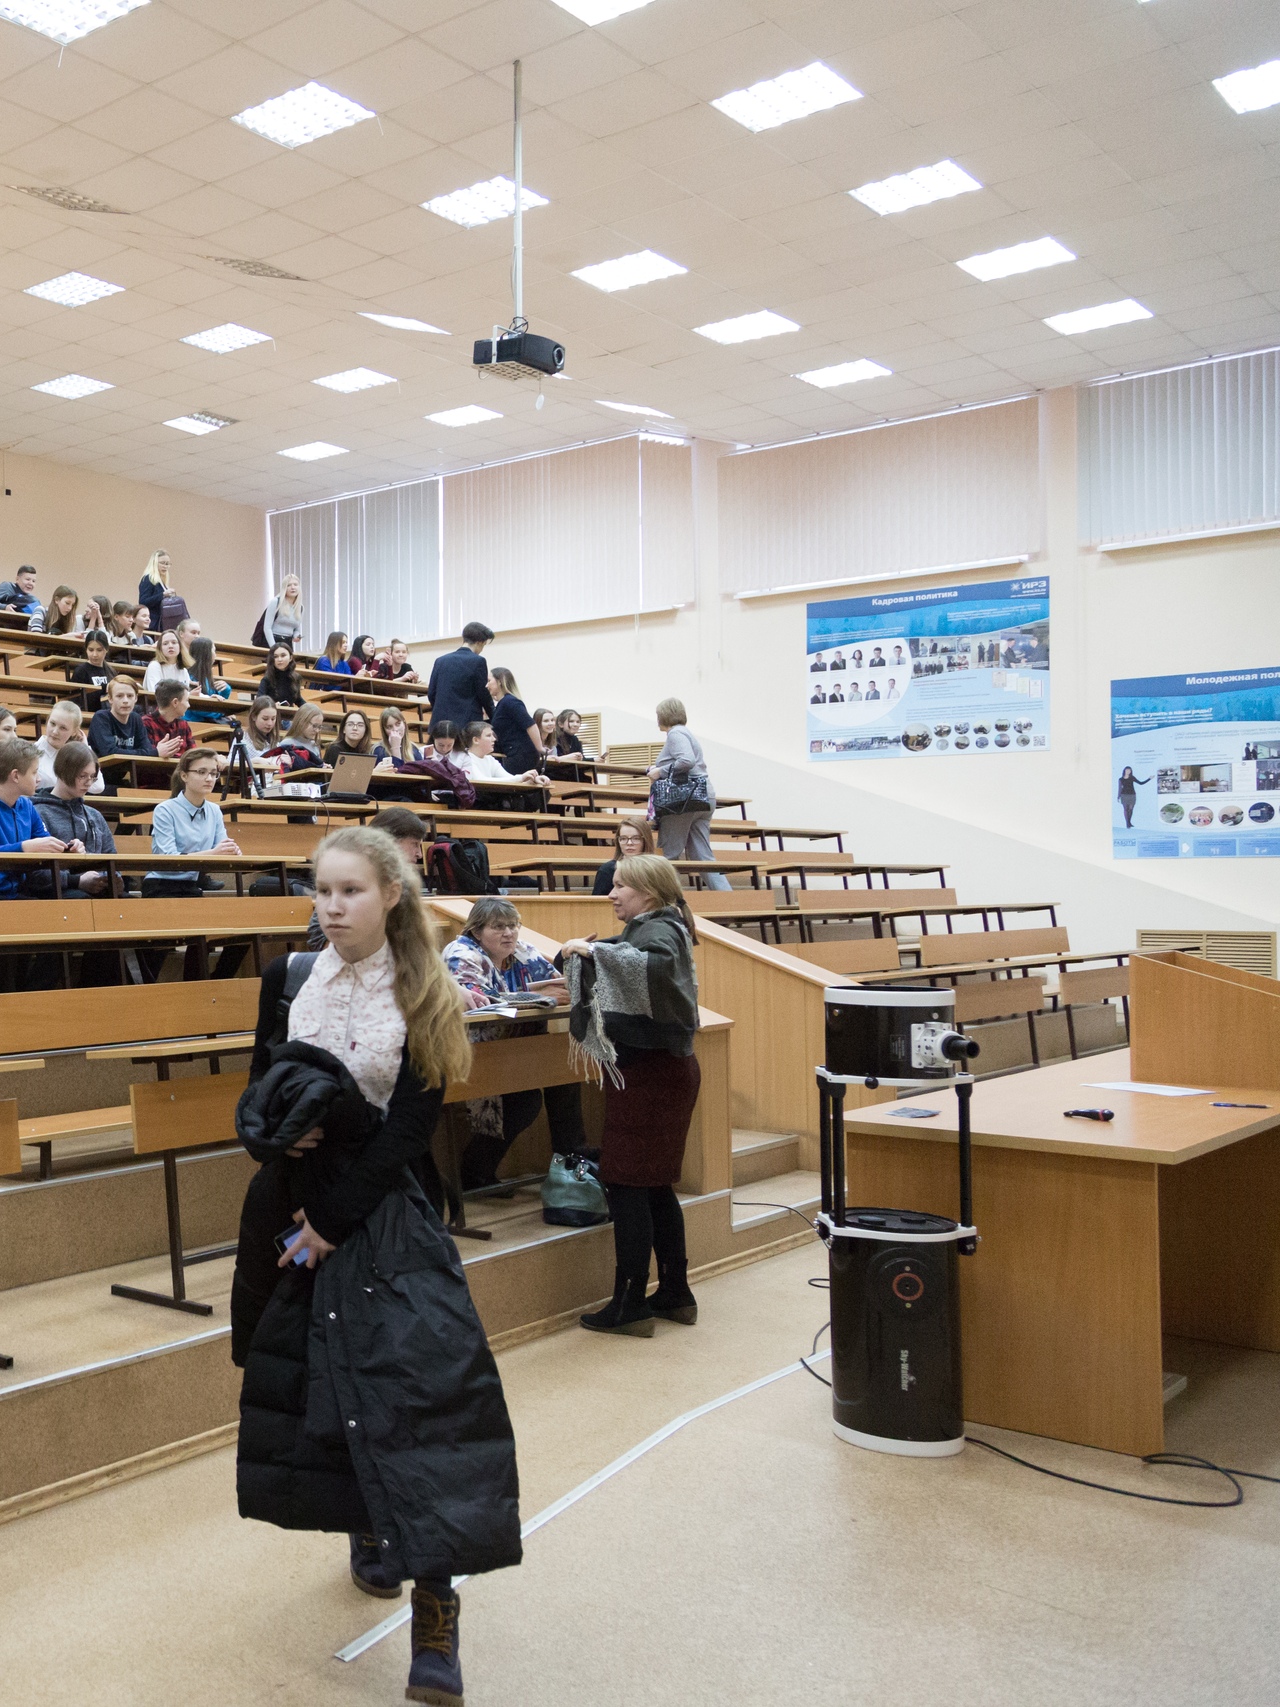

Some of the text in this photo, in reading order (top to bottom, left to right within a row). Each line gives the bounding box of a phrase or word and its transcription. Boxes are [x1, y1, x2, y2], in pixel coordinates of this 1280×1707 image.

[1022, 580, 1047, 589] ИРЗ
[871, 591, 958, 606] Кадровая политика
[1186, 672, 1280, 685] Молодежная пол
[900, 1349, 909, 1391] Sky-Watcher
